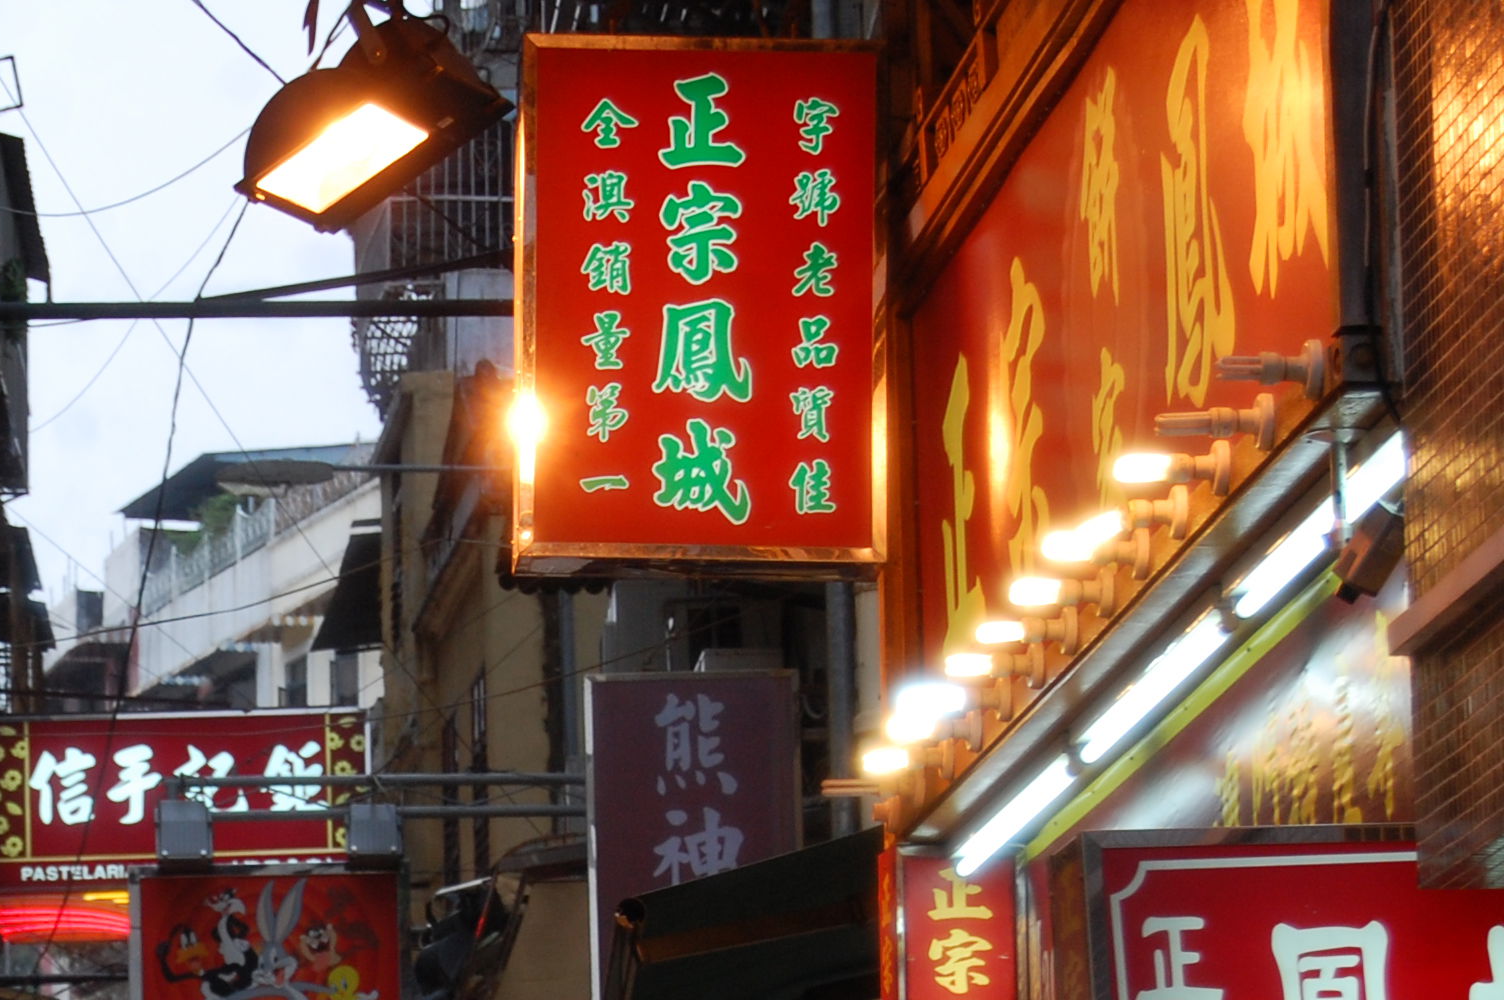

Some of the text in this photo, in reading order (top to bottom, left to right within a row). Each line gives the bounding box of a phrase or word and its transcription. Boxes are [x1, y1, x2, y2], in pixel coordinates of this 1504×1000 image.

[580, 97, 639, 493] 全澳銷量第一
[652, 72, 753, 525] 正宗鳳城
[788, 97, 841, 515] 字號老品質佳
[20, 864, 129, 882] PASTELARI
